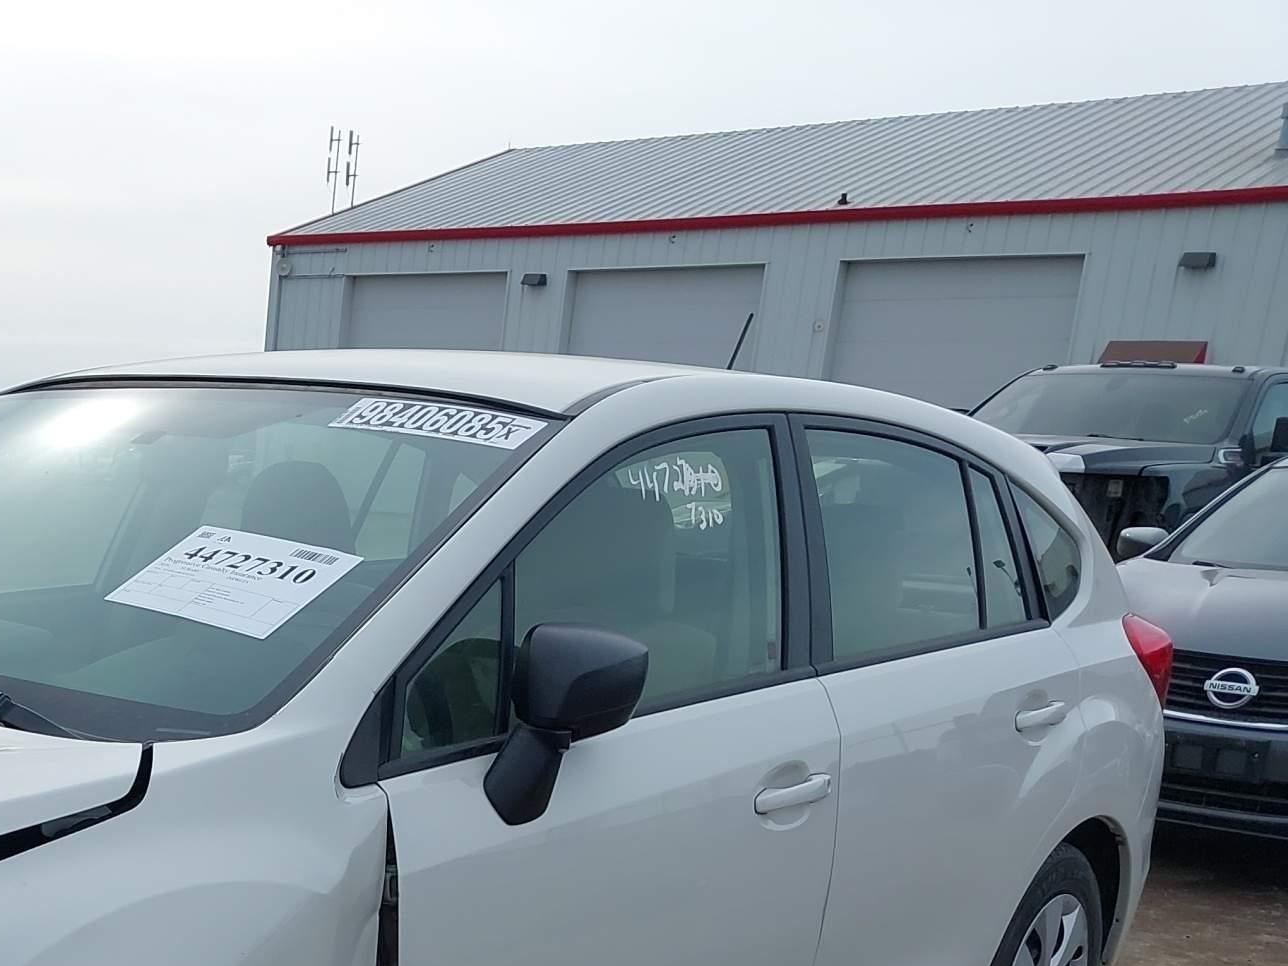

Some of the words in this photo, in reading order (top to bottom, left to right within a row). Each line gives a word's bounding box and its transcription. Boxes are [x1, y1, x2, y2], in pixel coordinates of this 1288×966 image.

[686, 502, 724, 531] 7310
[183, 546, 317, 584] 44727310
[1208, 681, 1252, 694] NISSAN
